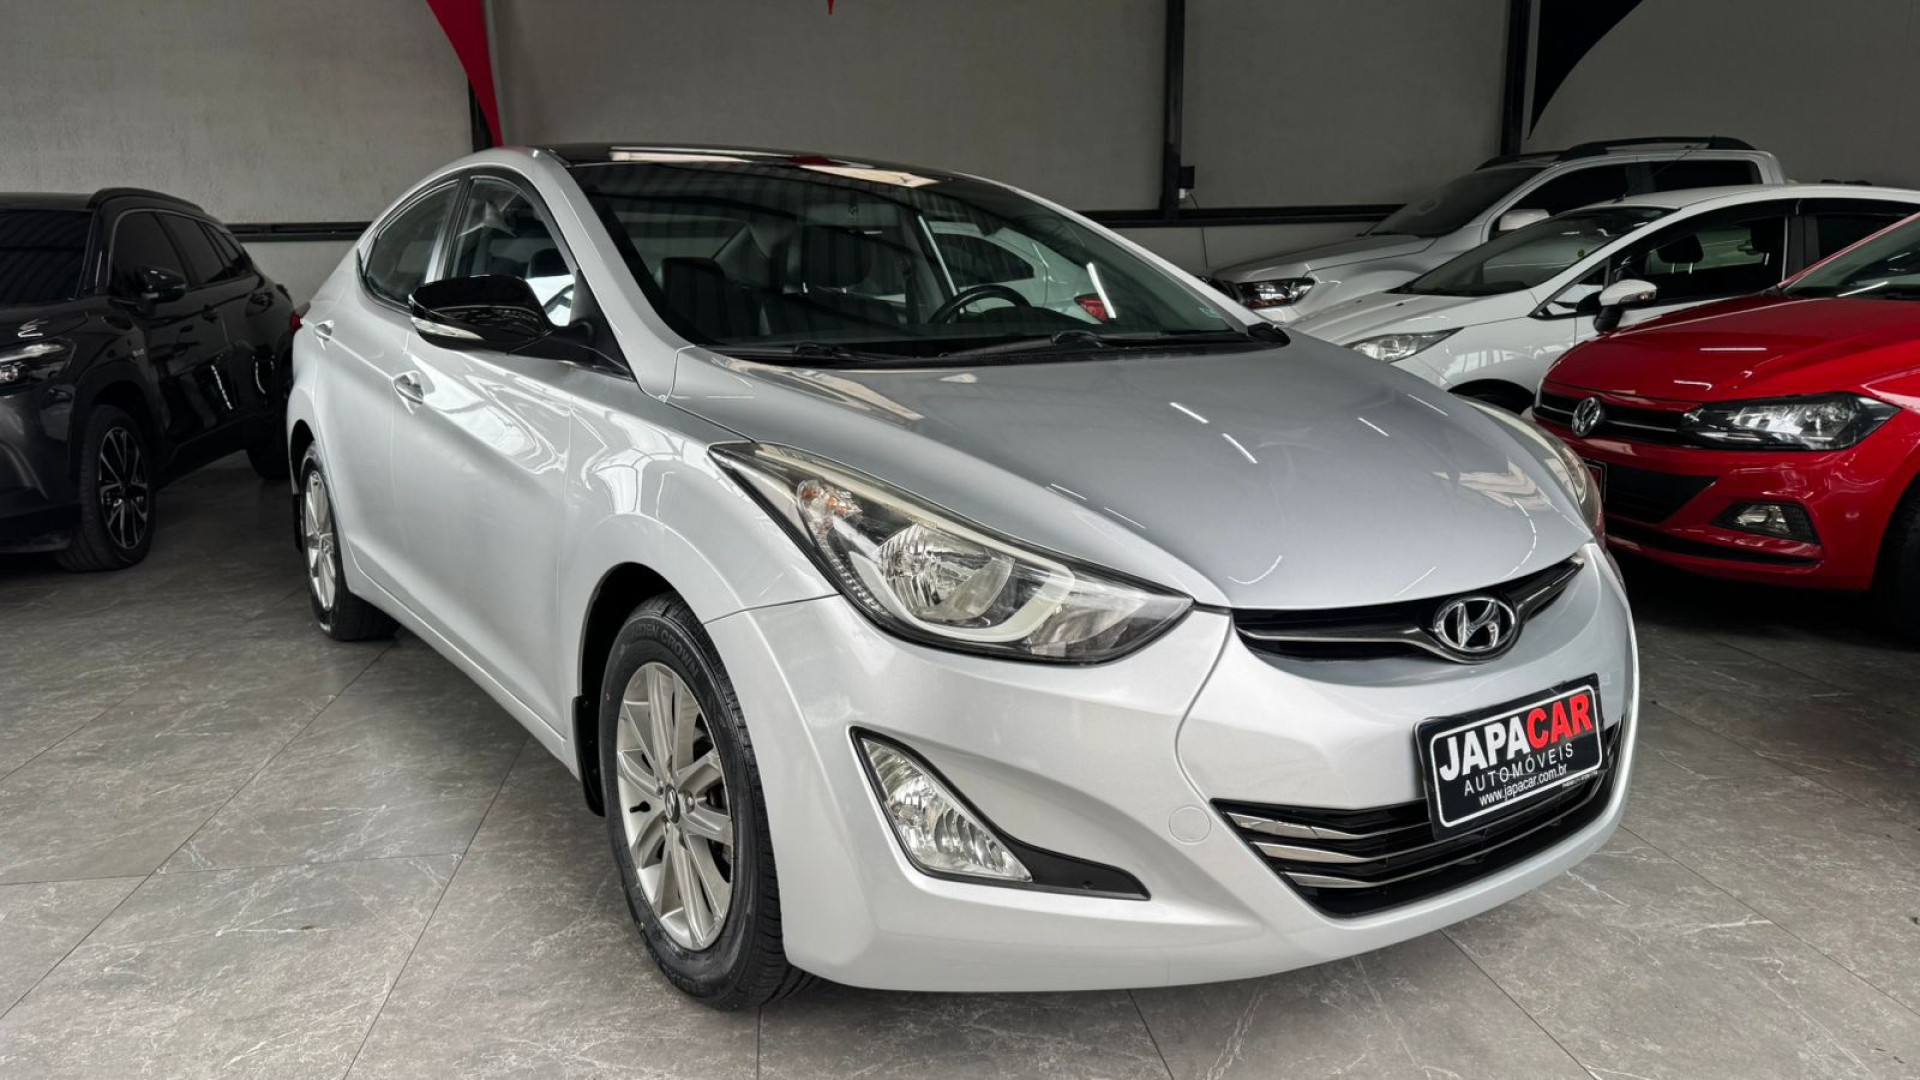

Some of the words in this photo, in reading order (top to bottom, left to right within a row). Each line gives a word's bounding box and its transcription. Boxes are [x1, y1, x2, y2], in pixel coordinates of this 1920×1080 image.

[661, 628, 699, 677] CROWN
[1439, 694, 1593, 781] JAPACAR
[1464, 742, 1574, 796] AUTOMÓVEIS
[1479, 764, 1567, 806] www.japacar.com.br
